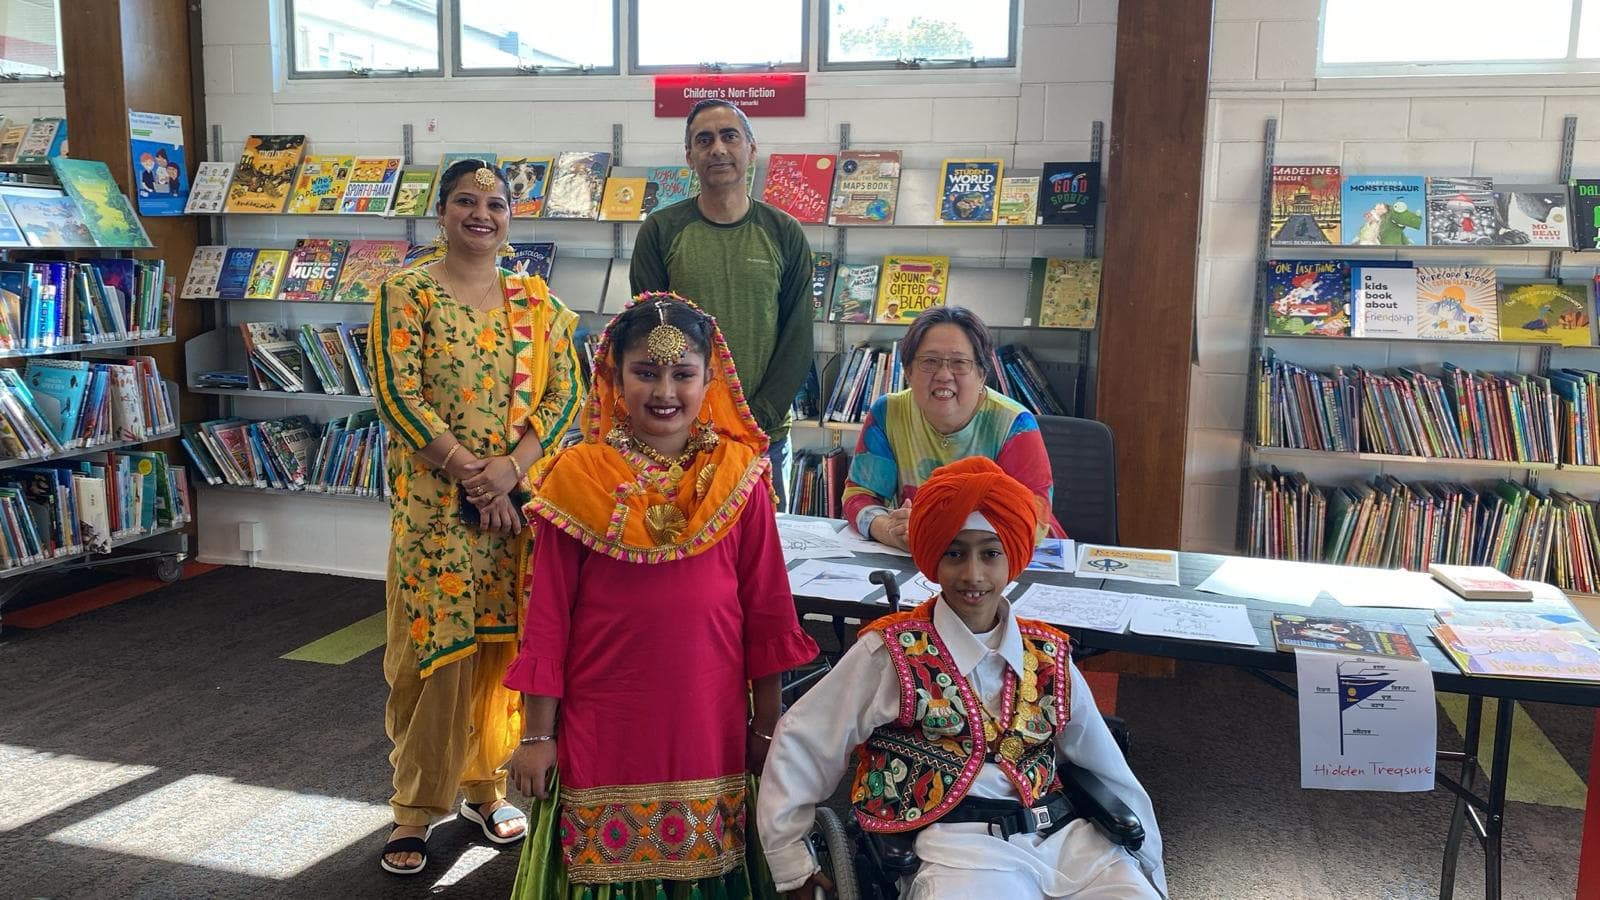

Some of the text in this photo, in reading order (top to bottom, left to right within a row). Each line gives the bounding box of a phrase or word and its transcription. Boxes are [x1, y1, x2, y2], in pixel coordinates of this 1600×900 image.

[683, 87, 776, 98] Children's Non-fiction
[948, 174, 995, 184] WORLD
[843, 182, 889, 190] MAPS BOOK
[950, 183, 990, 192] ATLAS
[1050, 193, 1089, 205] SPORTS
[288, 266, 336, 279] MUSIC
[1275, 263, 1292, 274] ONE
[892, 272, 926, 284] YOUNG
[1364, 282, 1389, 290] kids
[1364, 292, 1393, 300] book
[899, 296, 937, 309] BLACK
[1365, 301, 1399, 309] about
[1313, 761, 1432, 777] Hidden Treasure
